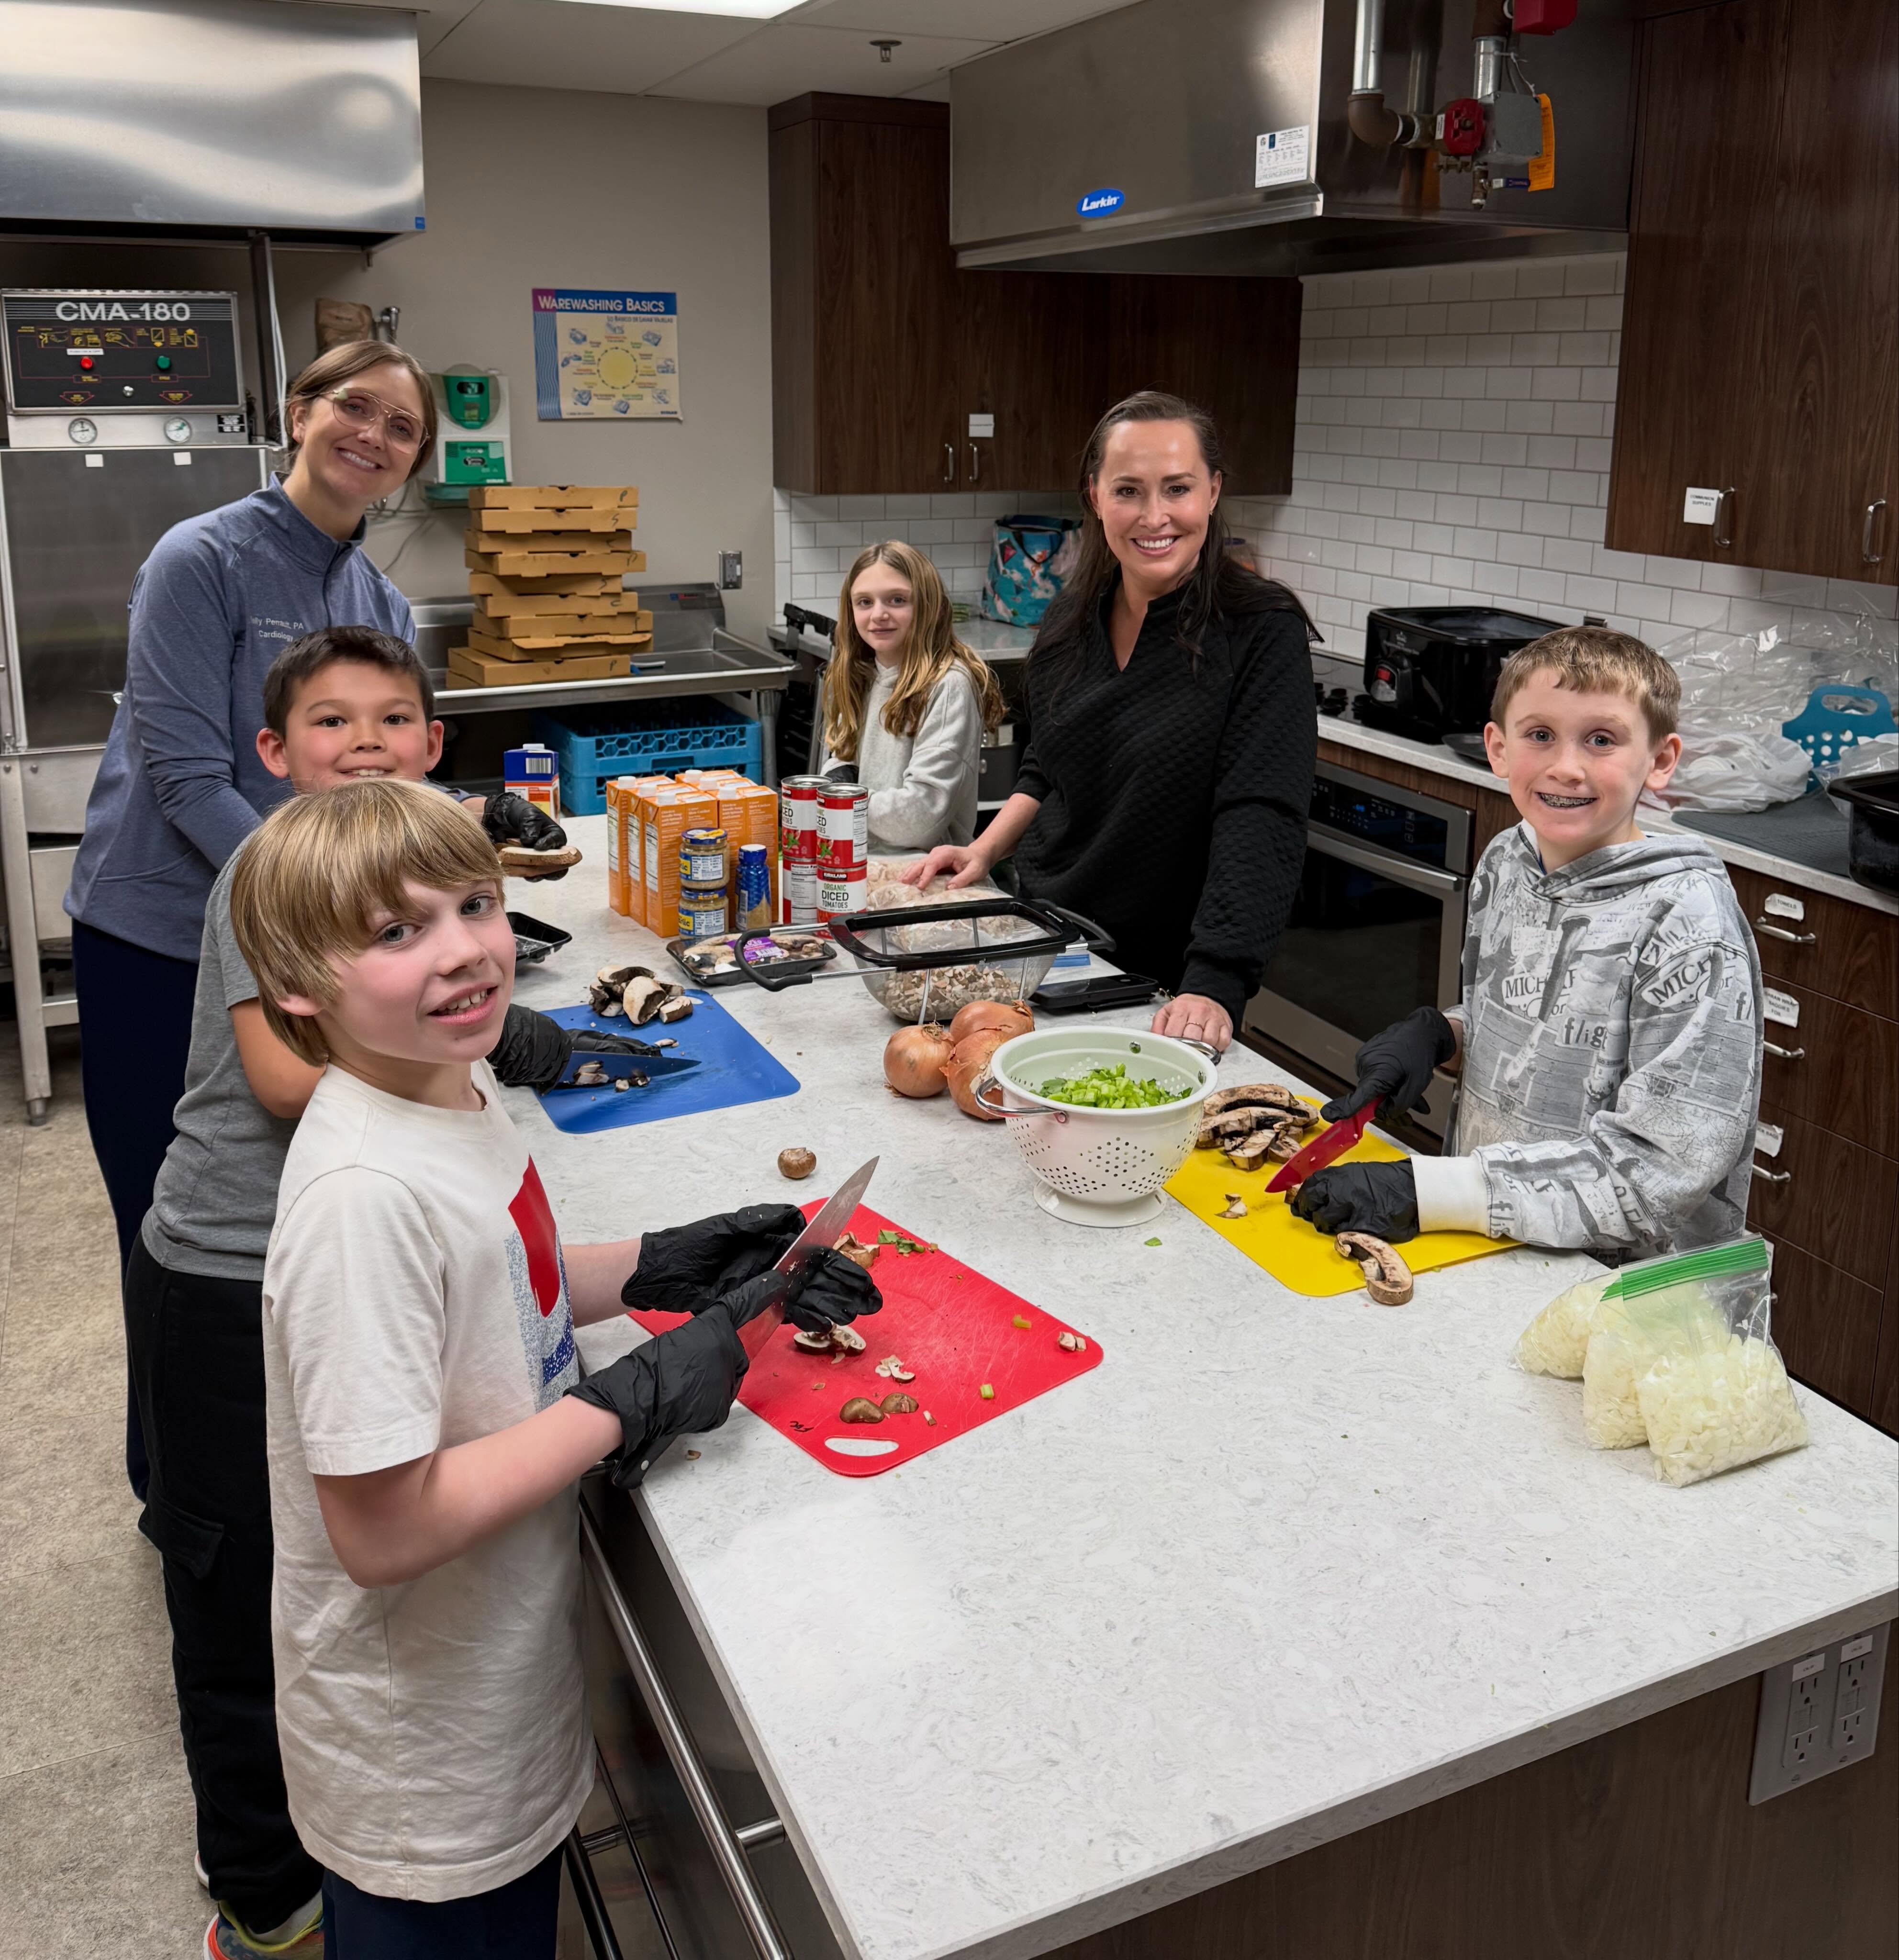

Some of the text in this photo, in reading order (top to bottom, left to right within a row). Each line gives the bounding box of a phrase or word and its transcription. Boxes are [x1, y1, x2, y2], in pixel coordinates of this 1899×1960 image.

[1082, 195, 1120, 212] Larkin
[537, 295, 665, 312] WAREWASHING BASICS
[55, 301, 191, 322] CMA-180
[258, 630, 293, 642] Cardiology
[824, 883, 847, 891] ORGANIC
[822, 890, 849, 902] DICED
[822, 900, 848, 908] TOMATOES
[1777, 898, 1797, 909] TOWELS
